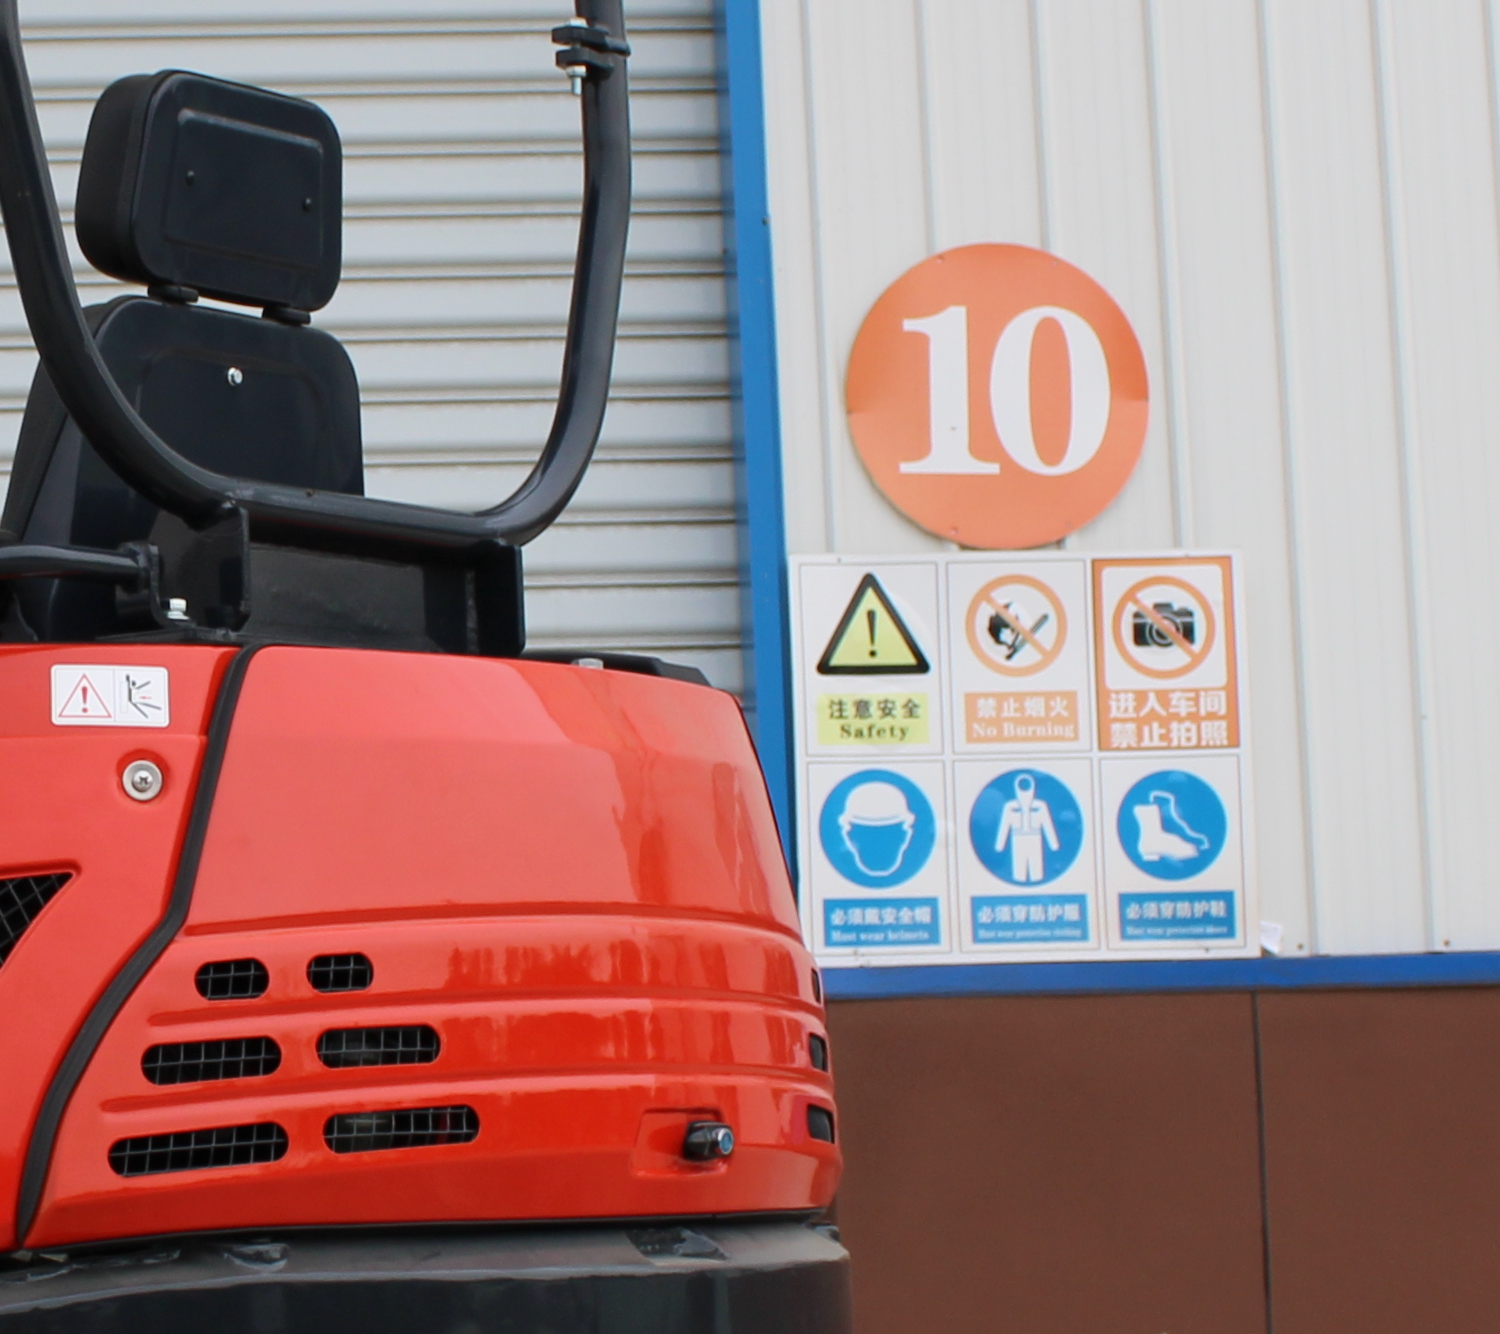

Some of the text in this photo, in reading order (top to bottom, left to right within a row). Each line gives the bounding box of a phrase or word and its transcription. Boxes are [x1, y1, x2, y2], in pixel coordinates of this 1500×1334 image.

[898, 304, 1111, 477] 10
[827, 697, 922, 720] 注意安全
[976, 696, 1070, 718] 禁止烟火
[1108, 690, 1228, 719] 进入车间
[839, 722, 911, 740] Safety
[972, 720, 1075, 738] No Burning
[1109, 720, 1229, 749] 禁止拍照
